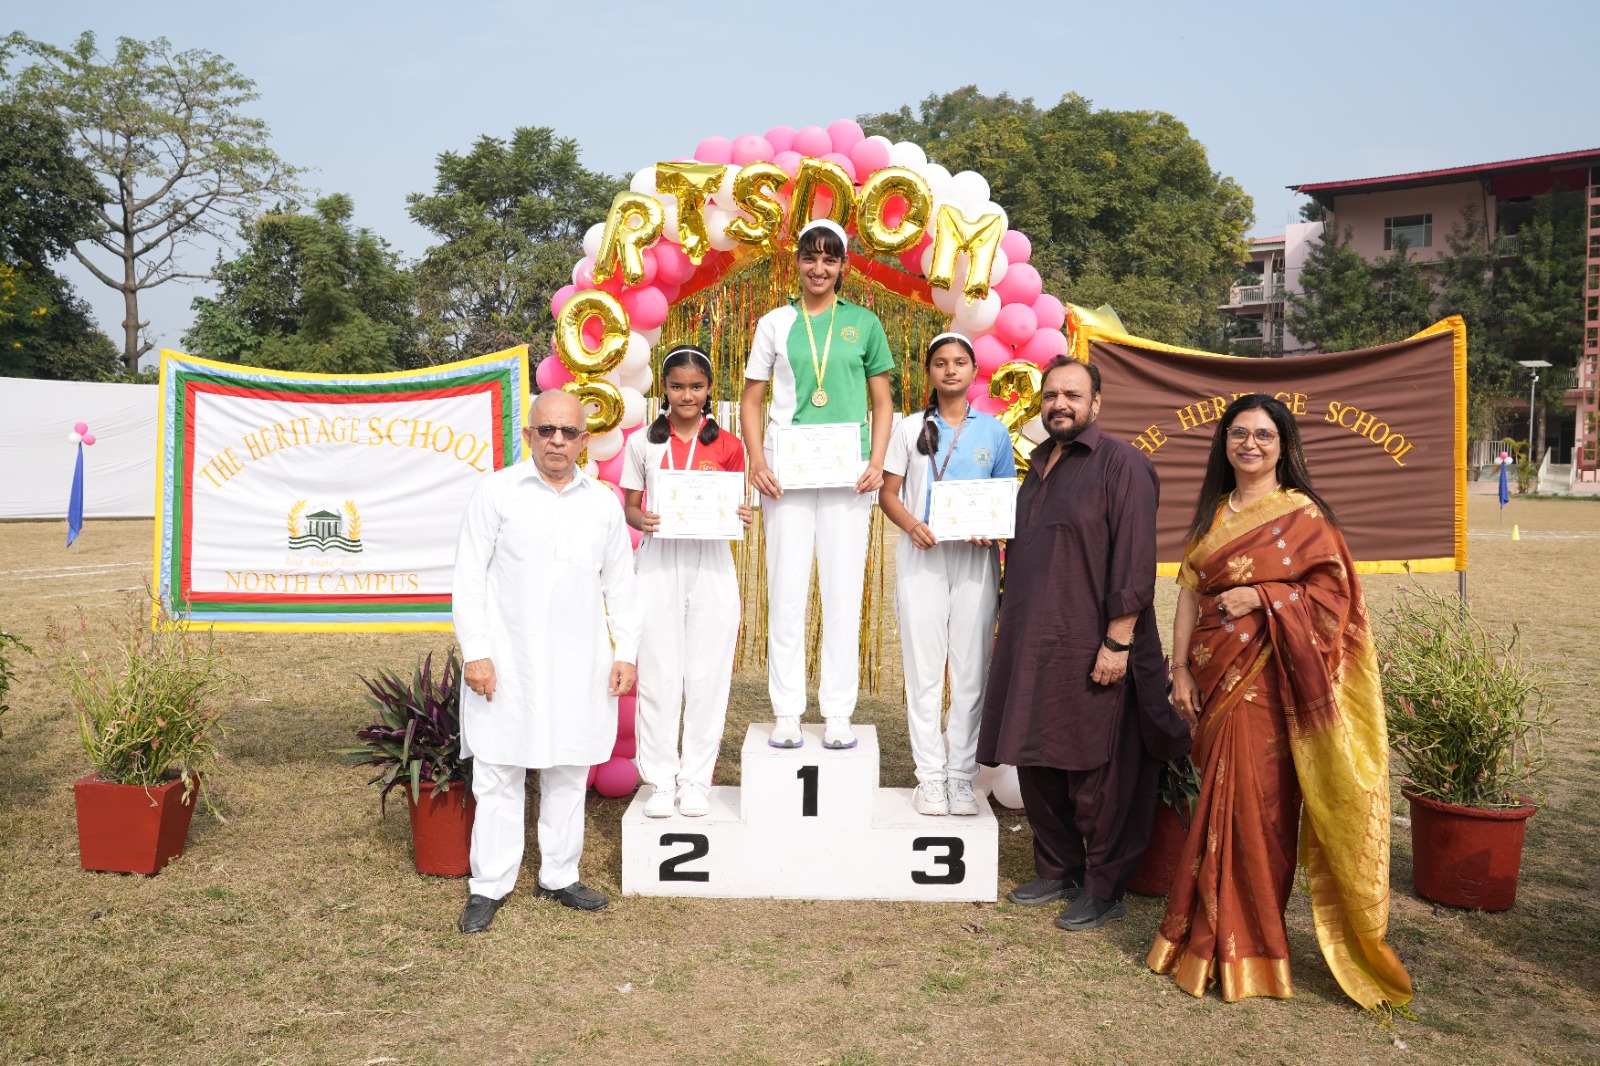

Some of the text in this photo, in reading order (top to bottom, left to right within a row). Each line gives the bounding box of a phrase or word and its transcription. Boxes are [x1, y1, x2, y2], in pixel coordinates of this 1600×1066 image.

[198, 416, 488, 489] THE HERITAGE SCHOOL
[1131, 392, 1415, 467] HE HERGE SCHOOL
[224, 570, 419, 593] NORTH CAMPUS
[797, 765, 819, 817] 1
[659, 833, 710, 882] 2
[911, 836, 966, 884] 3
